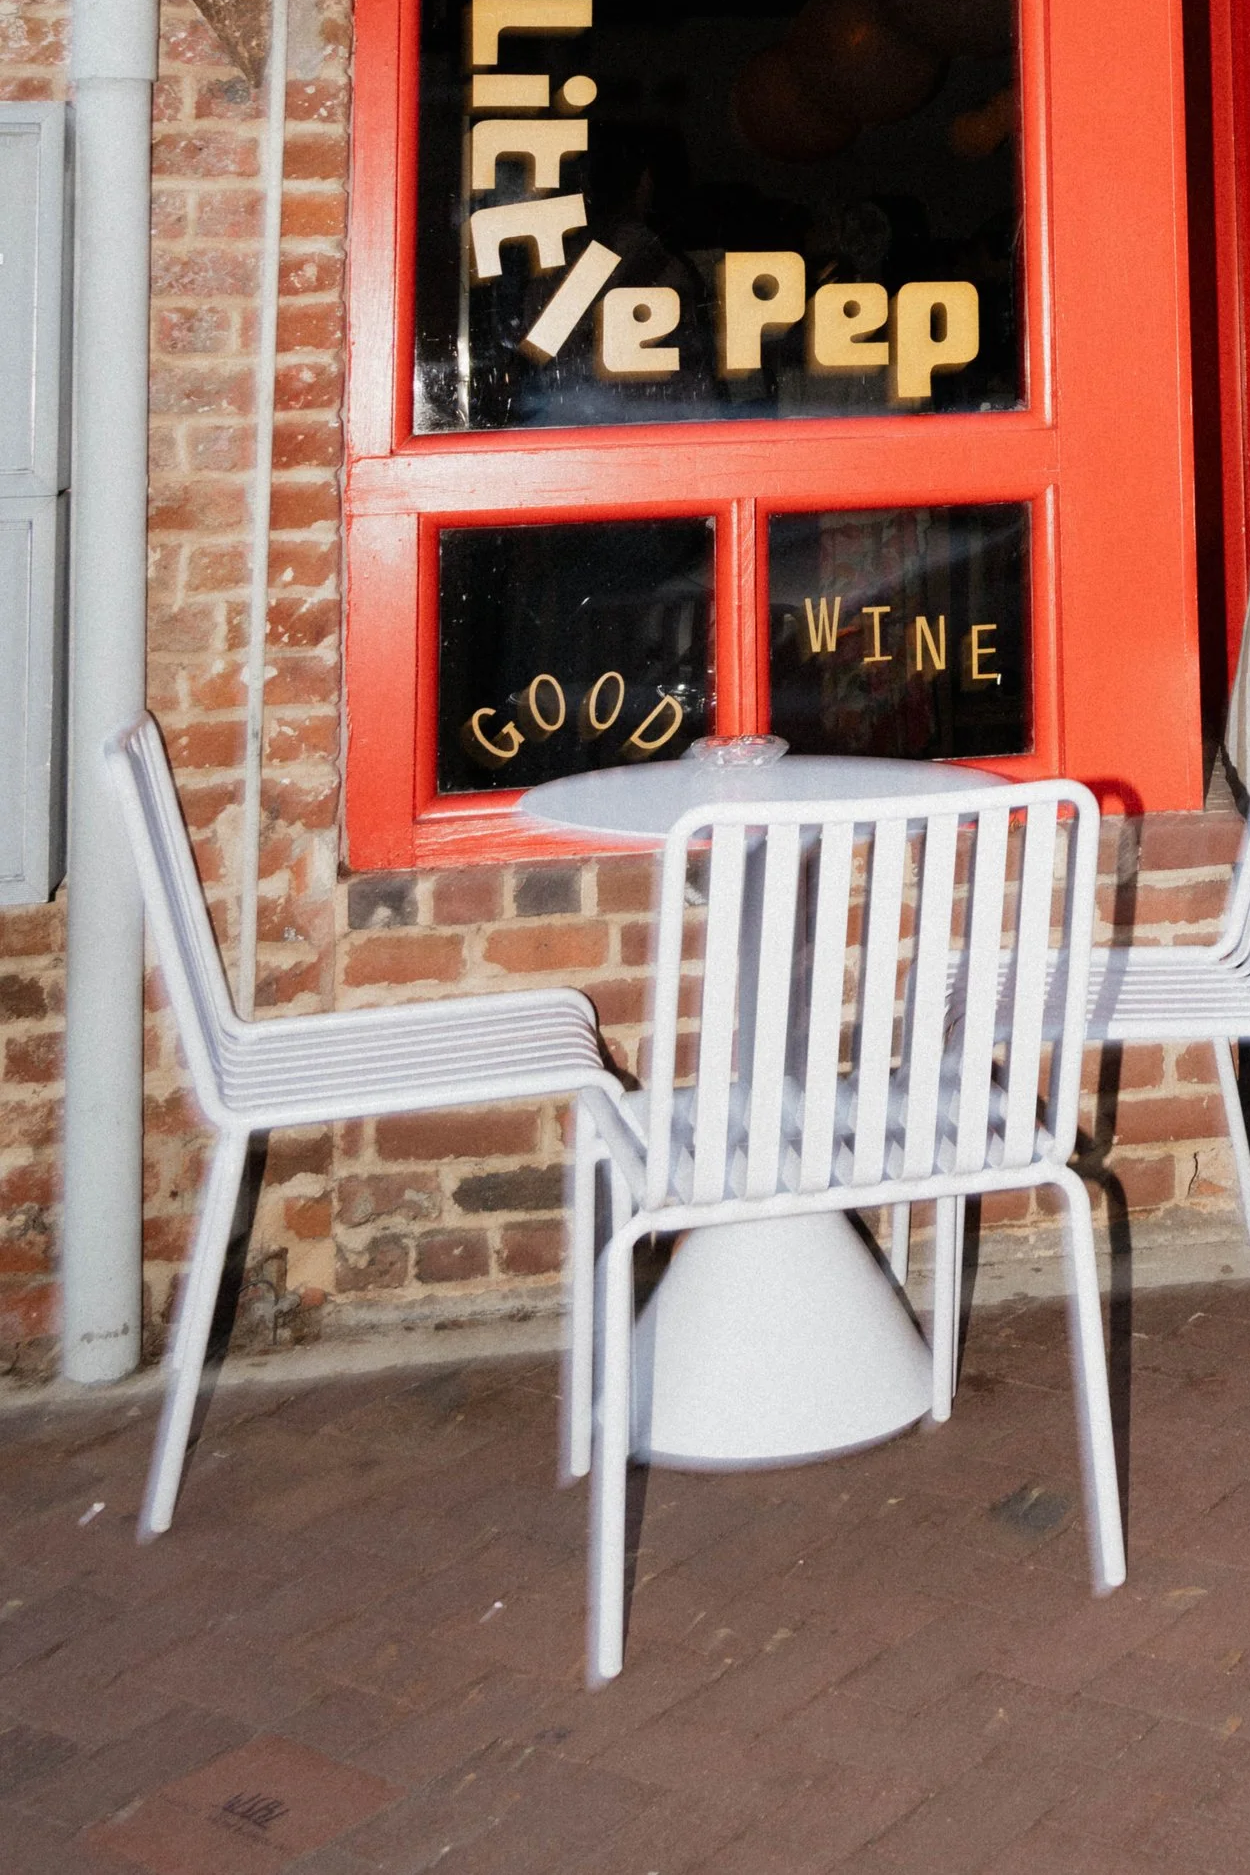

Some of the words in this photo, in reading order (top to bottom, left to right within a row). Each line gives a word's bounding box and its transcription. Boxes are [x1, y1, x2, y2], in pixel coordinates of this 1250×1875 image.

[725, 251, 980, 398] Pep
[471, 670, 683, 759] GOOD
[805, 596, 999, 681] WINE
